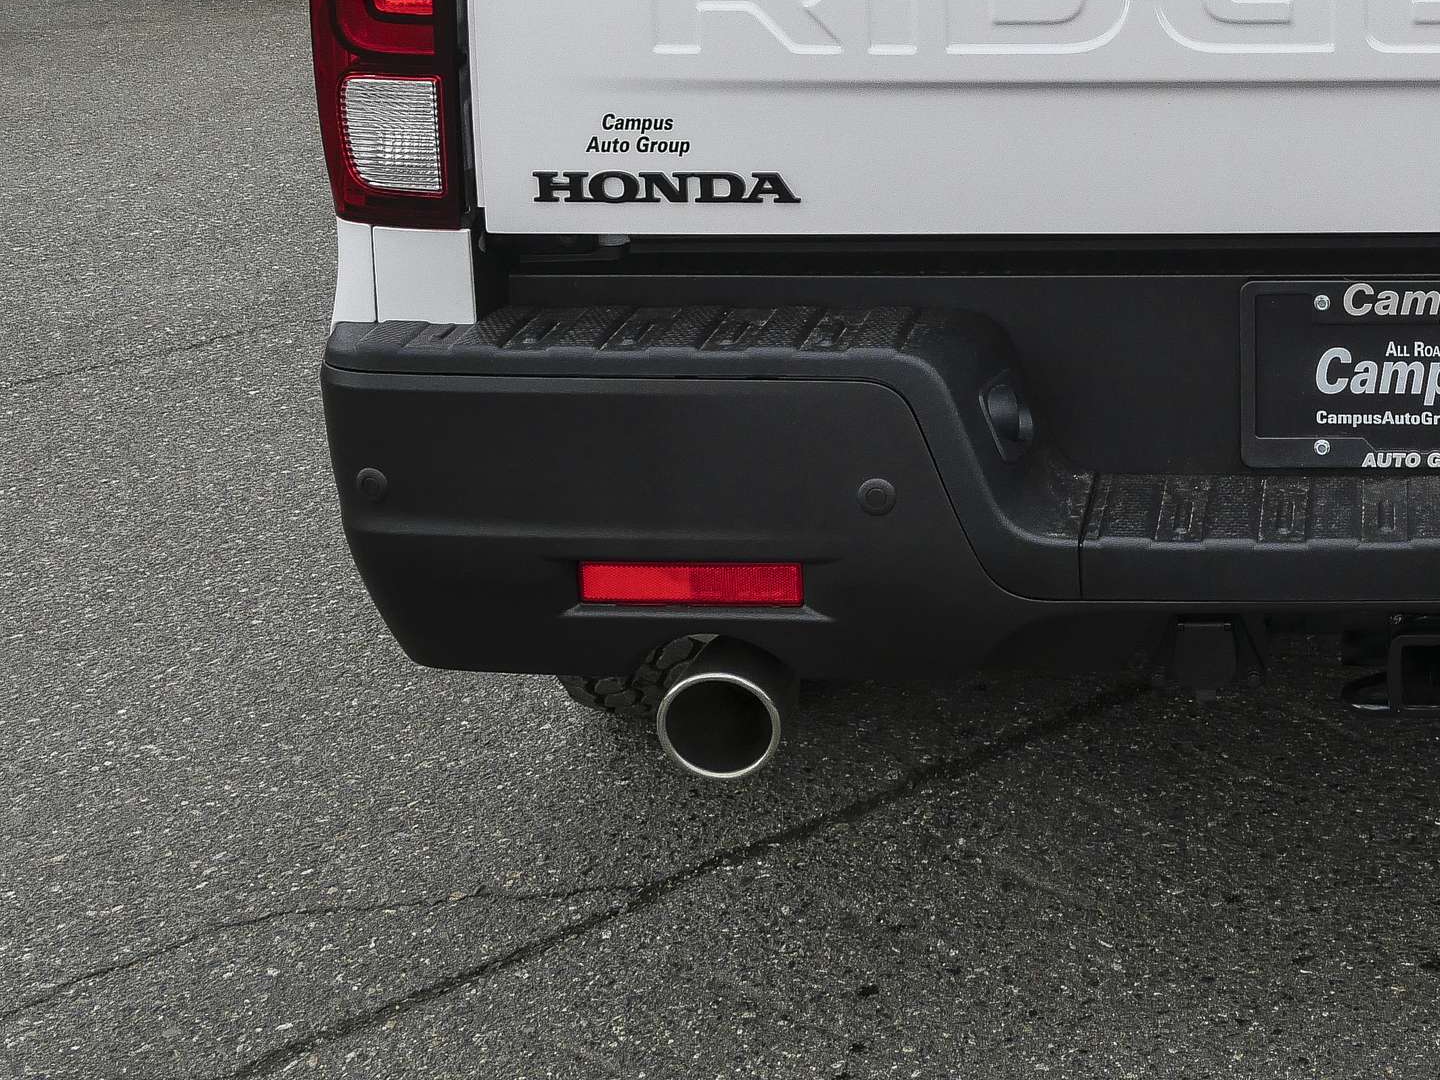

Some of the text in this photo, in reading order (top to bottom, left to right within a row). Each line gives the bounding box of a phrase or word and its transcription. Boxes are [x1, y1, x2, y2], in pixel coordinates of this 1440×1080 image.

[602, 113, 674, 133] Campus
[586, 137, 690, 156] Auto Group
[532, 170, 801, 203] HONDA
[1362, 452, 1421, 468] AUTO
